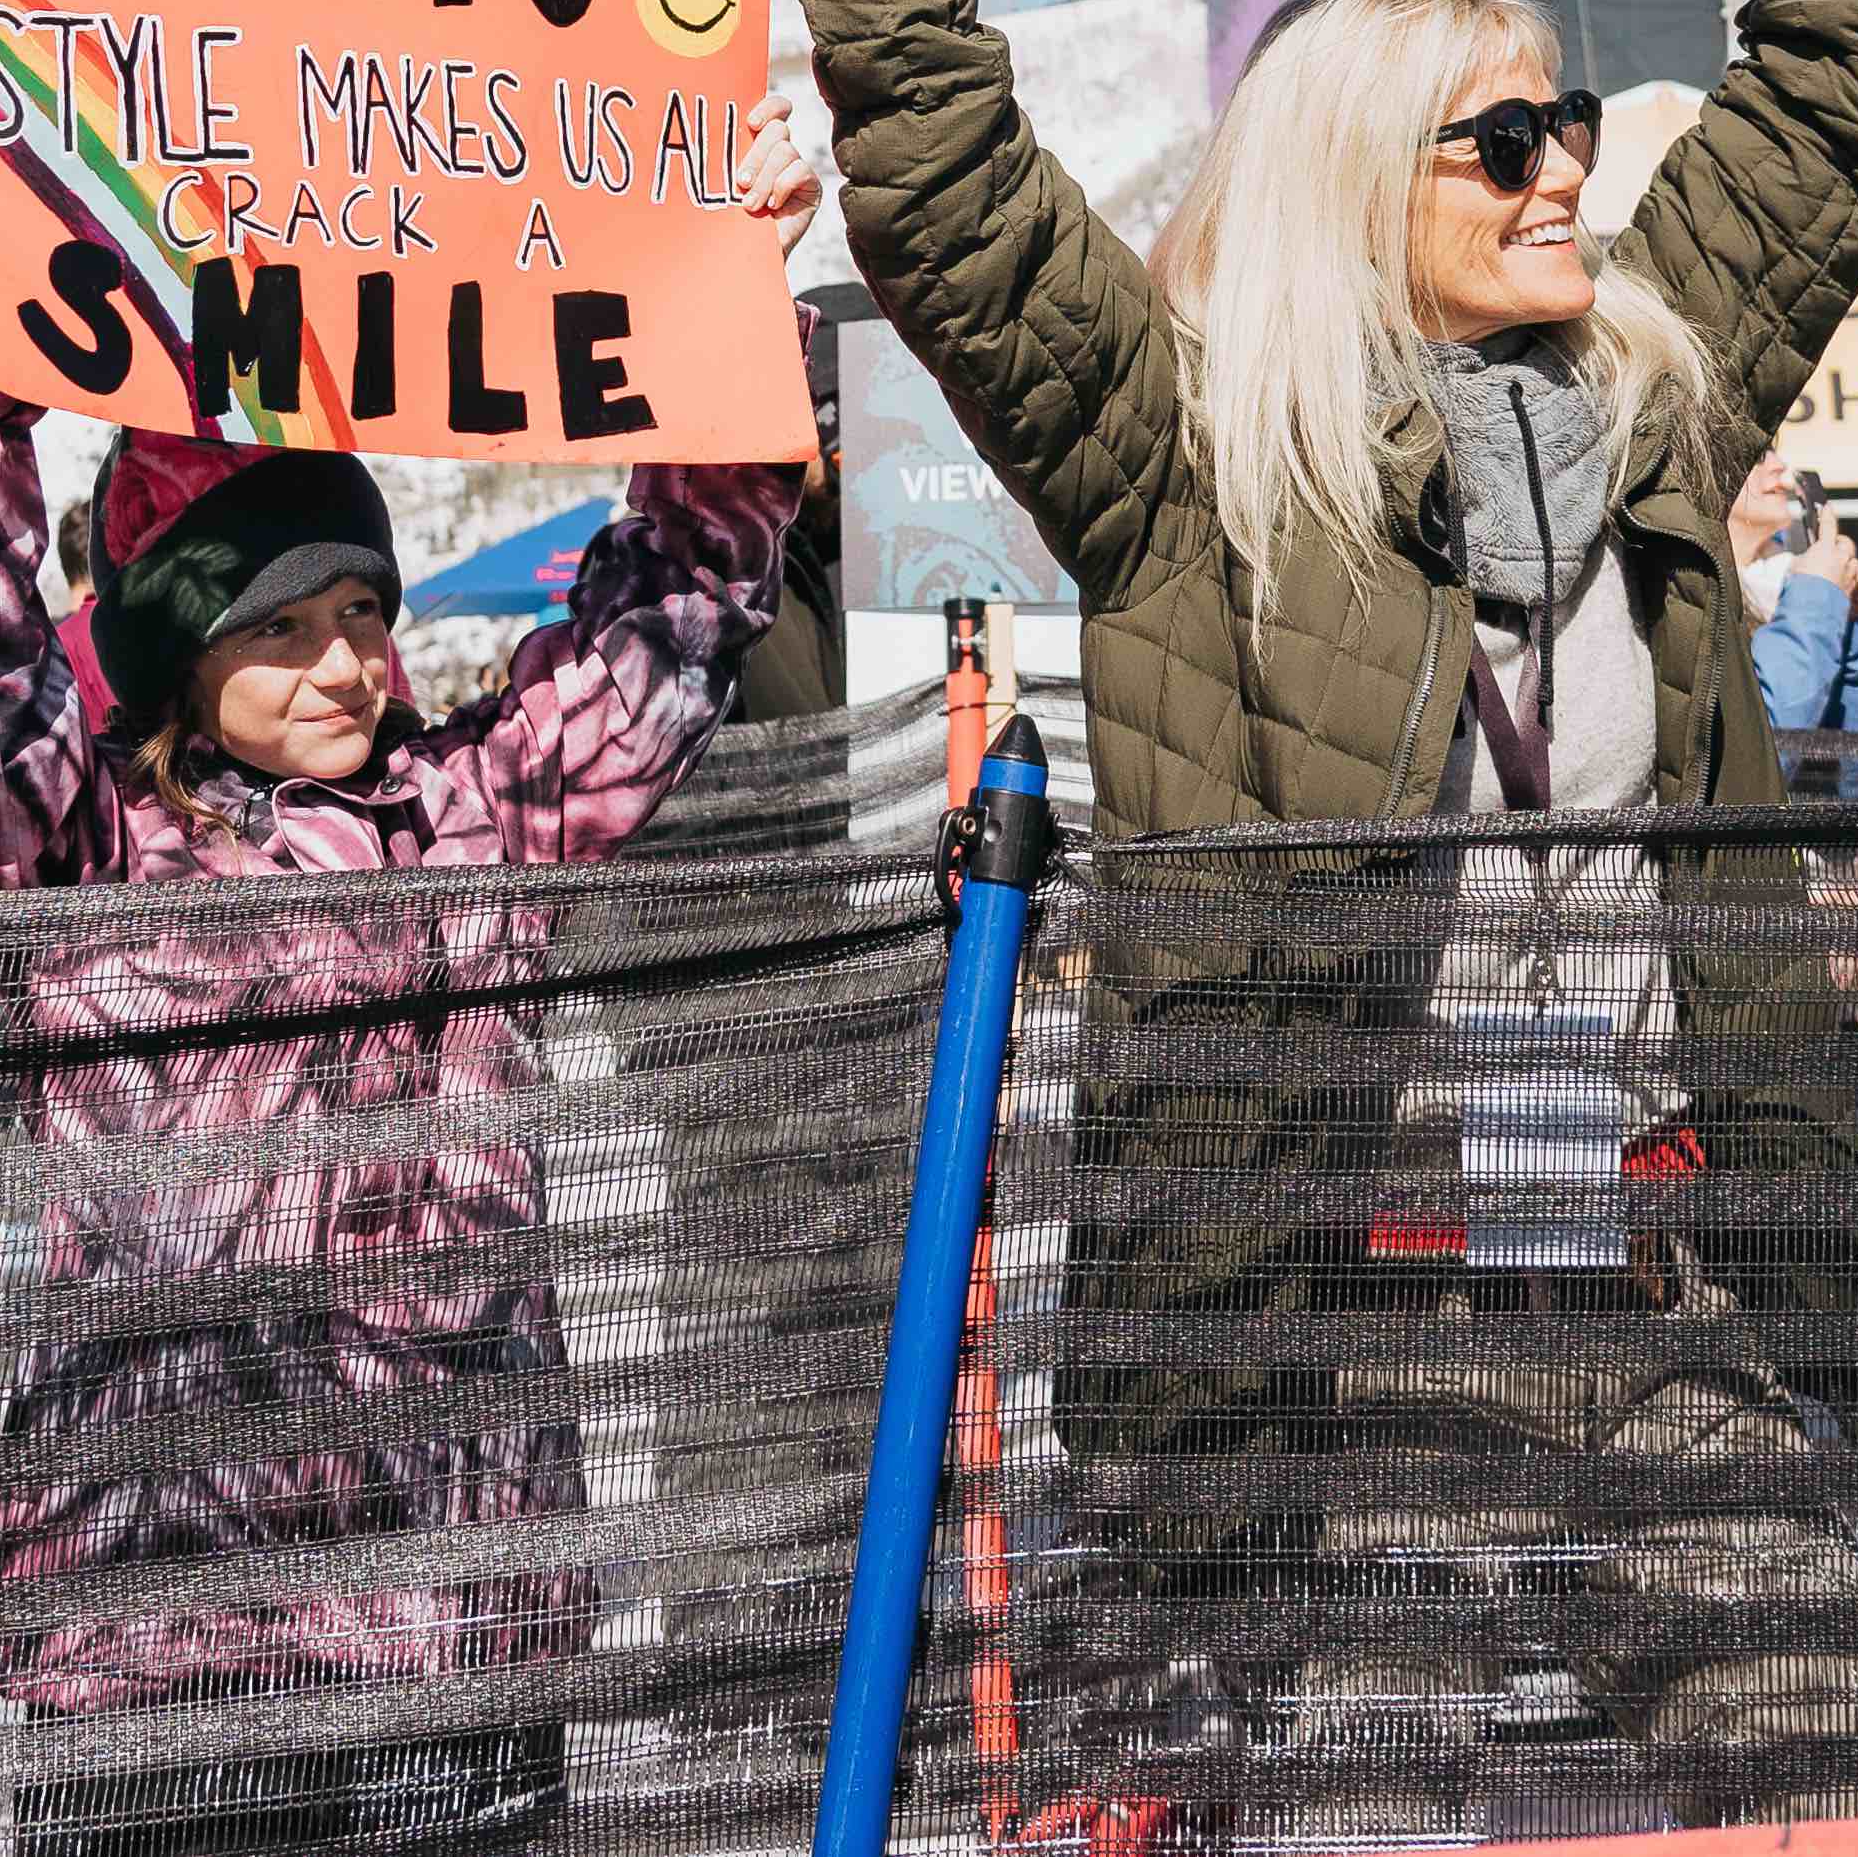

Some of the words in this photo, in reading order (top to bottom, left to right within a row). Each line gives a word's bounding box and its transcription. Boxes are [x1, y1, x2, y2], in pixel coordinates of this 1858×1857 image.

[294, 42, 531, 184] MAKES
[554, 77, 639, 195] US
[650, 88, 744, 211] ALL
[157, 170, 440, 259] CRACK
[514, 198, 566, 271] A
[16, 241, 659, 442] SMILE
